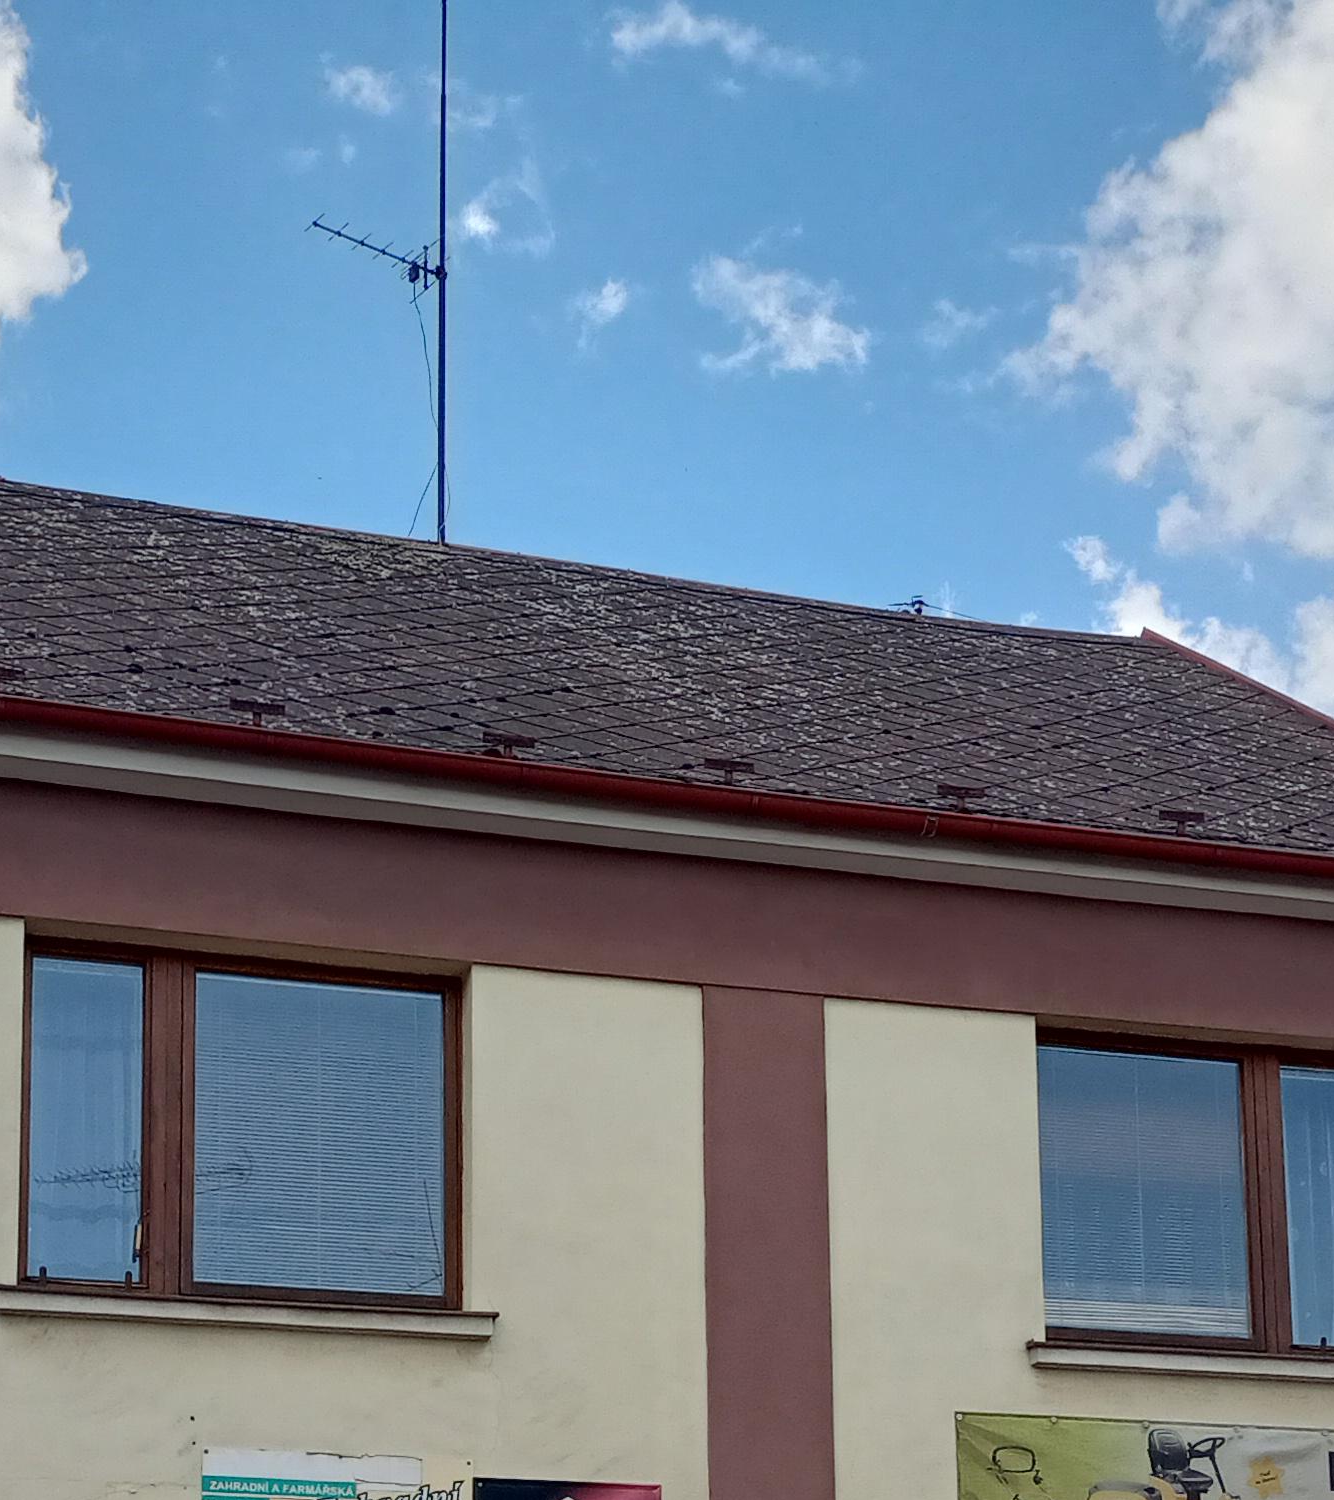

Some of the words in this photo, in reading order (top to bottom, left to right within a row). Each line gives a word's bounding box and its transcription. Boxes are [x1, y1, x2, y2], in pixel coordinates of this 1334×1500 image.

[209, 1479, 269, 1493] ZAHRADNÍ
[271, 1483, 280, 1493] A
[282, 1482, 355, 1497] FARMÁŘSKÁ
